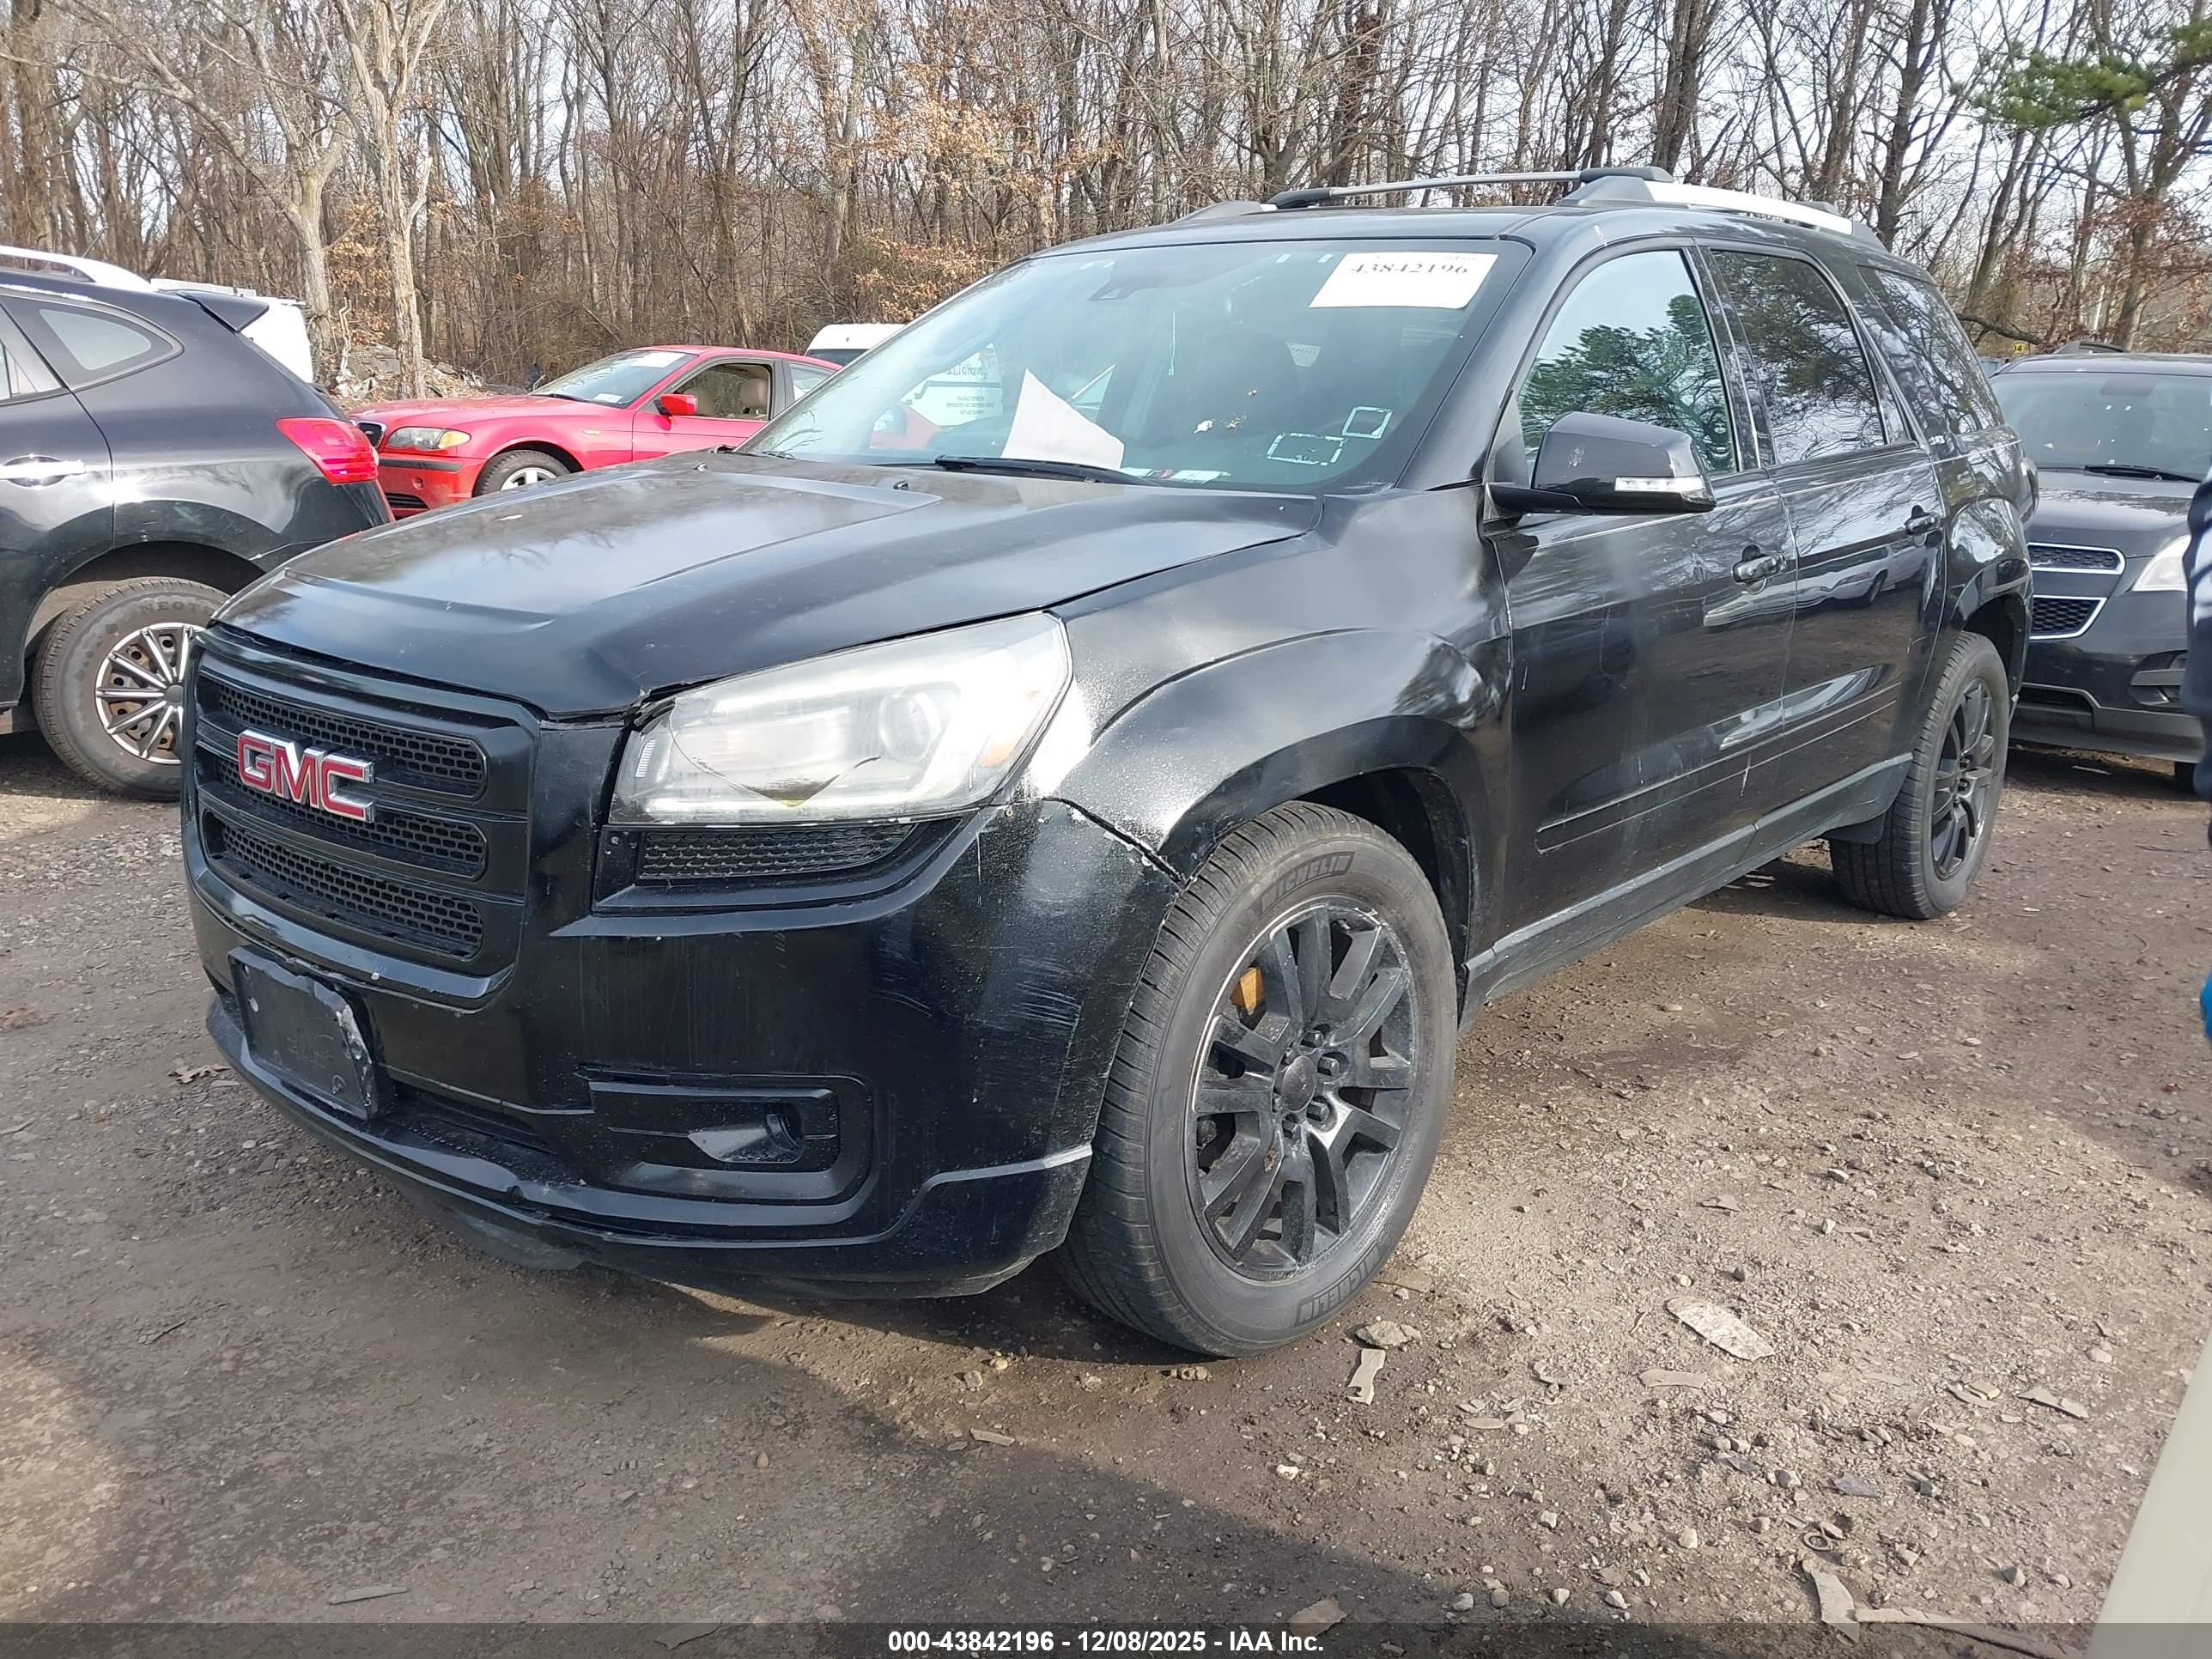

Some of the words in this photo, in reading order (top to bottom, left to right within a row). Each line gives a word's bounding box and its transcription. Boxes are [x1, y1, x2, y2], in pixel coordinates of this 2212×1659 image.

[1350, 264, 1468, 275] 43842196
[238, 730, 375, 823] GMC
[1255, 853, 1354, 915] MICHELIN
